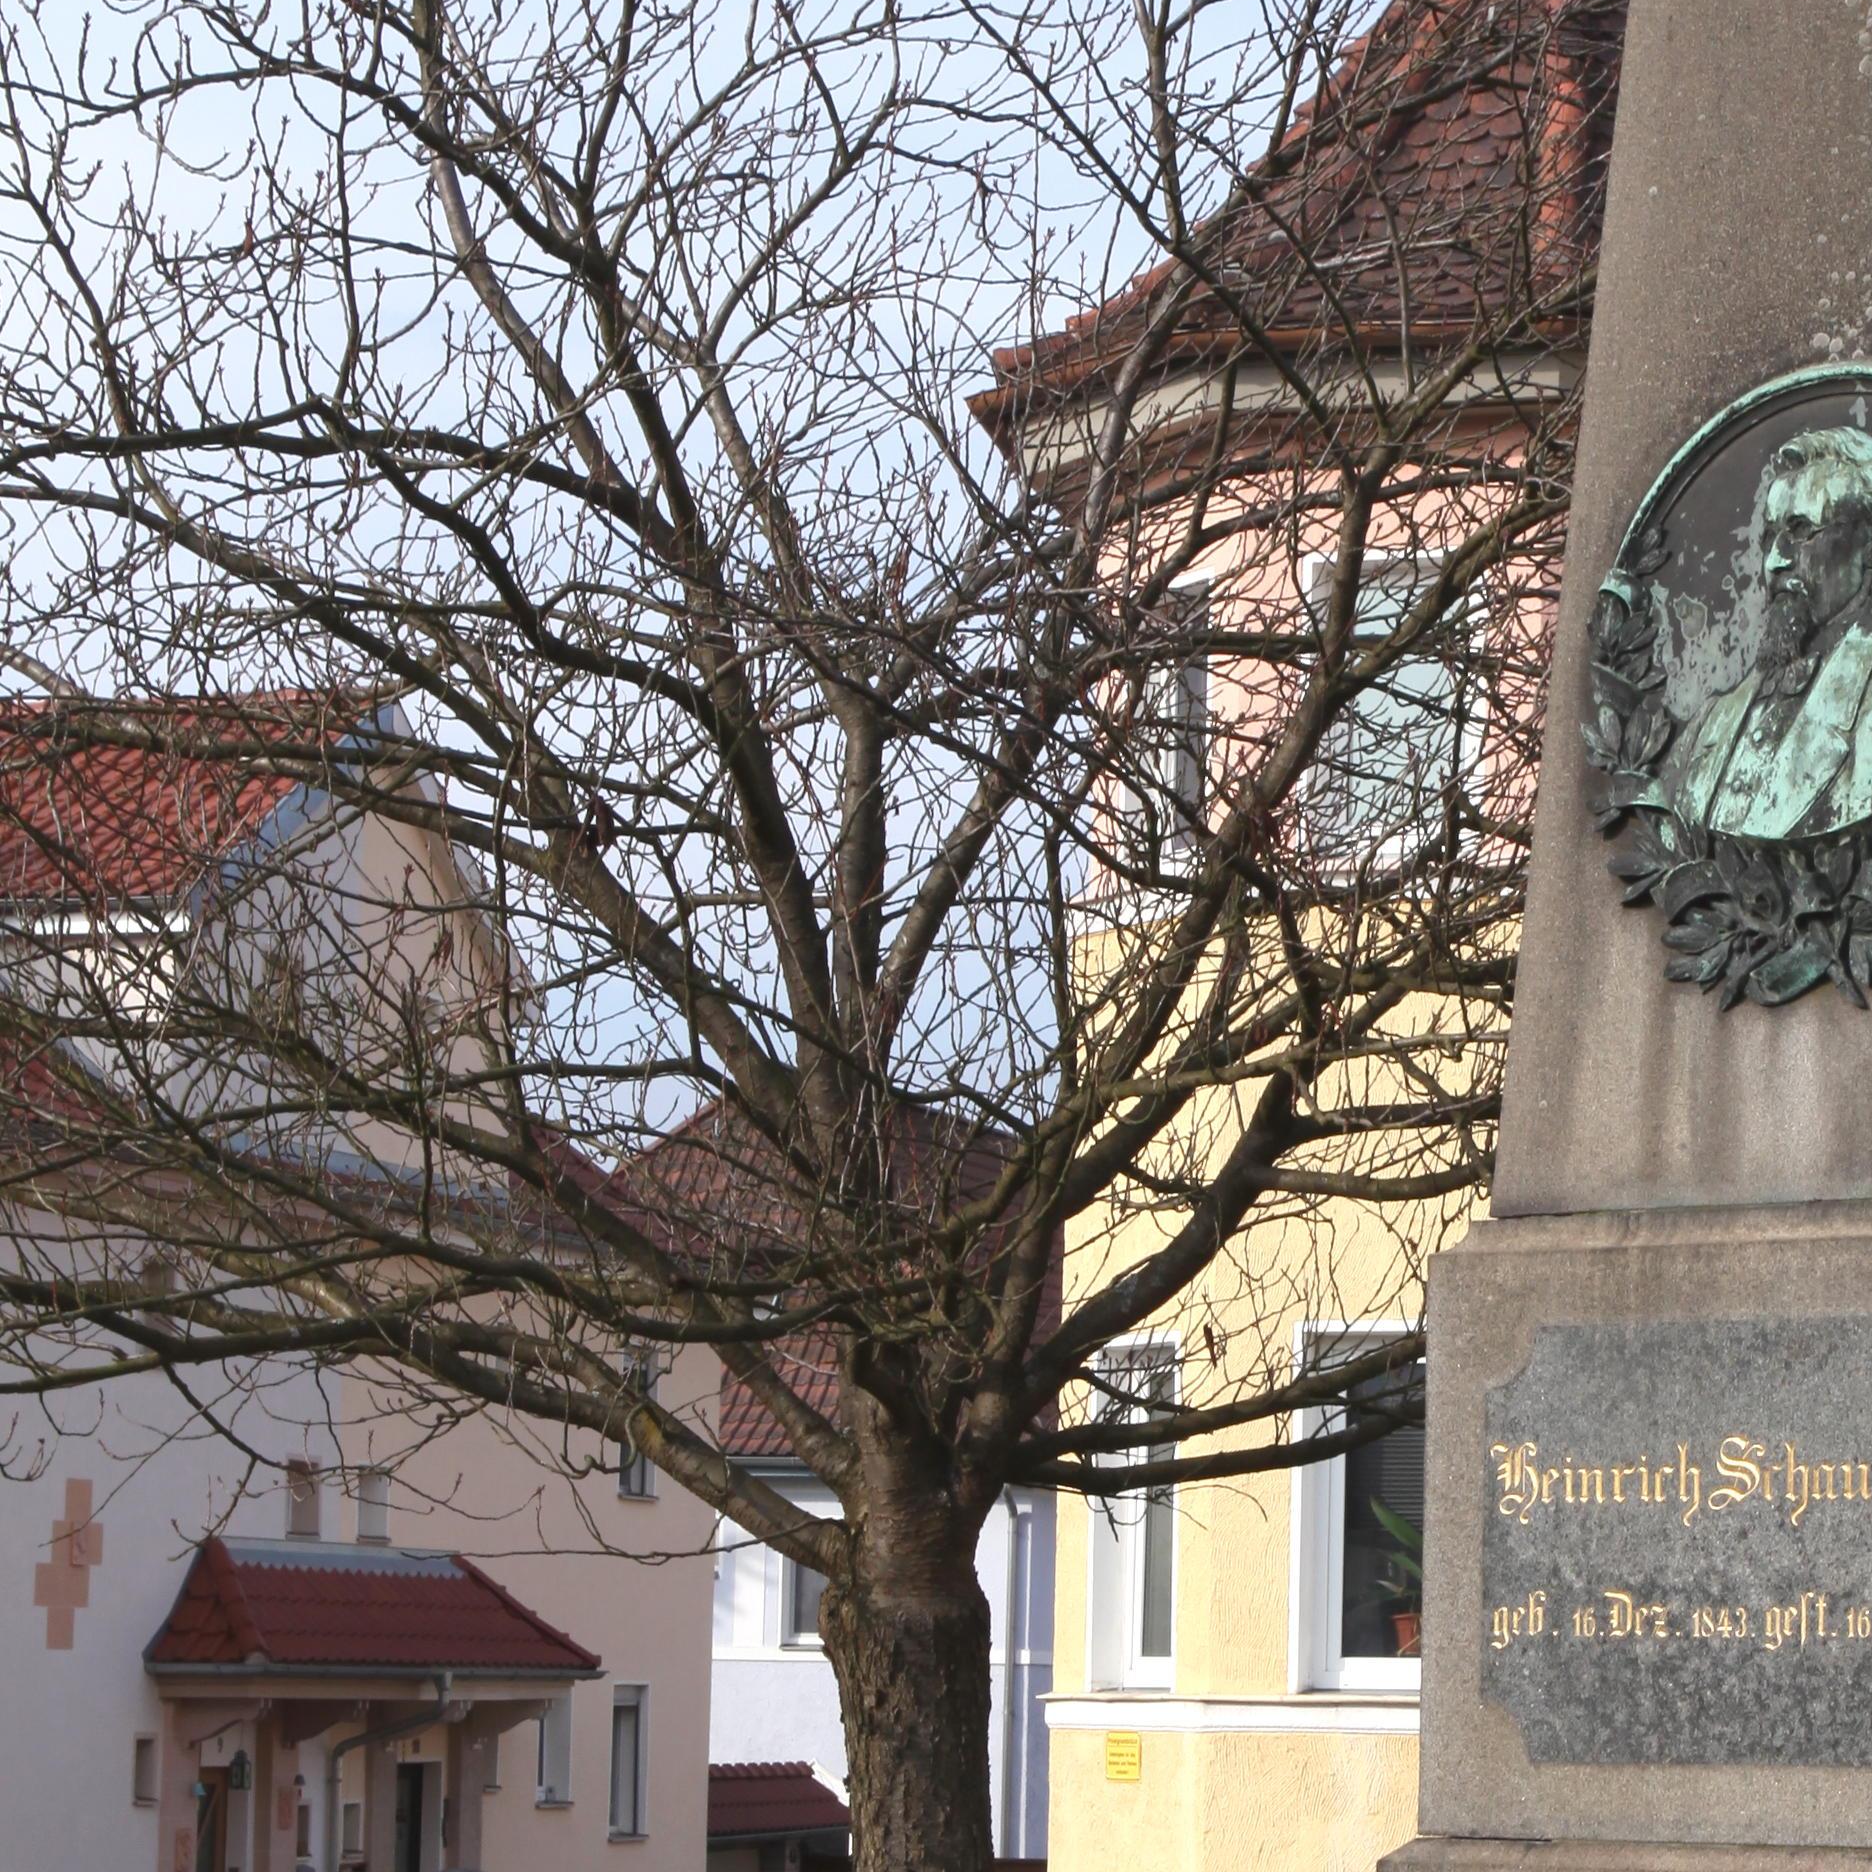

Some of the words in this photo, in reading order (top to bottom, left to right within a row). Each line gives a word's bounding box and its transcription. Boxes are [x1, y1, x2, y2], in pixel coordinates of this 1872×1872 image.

[1490, 1441, 1701, 1527] Heinrich
[1491, 1590, 1559, 1649] geb.
[1692, 1606, 1756, 1638] 1843.
